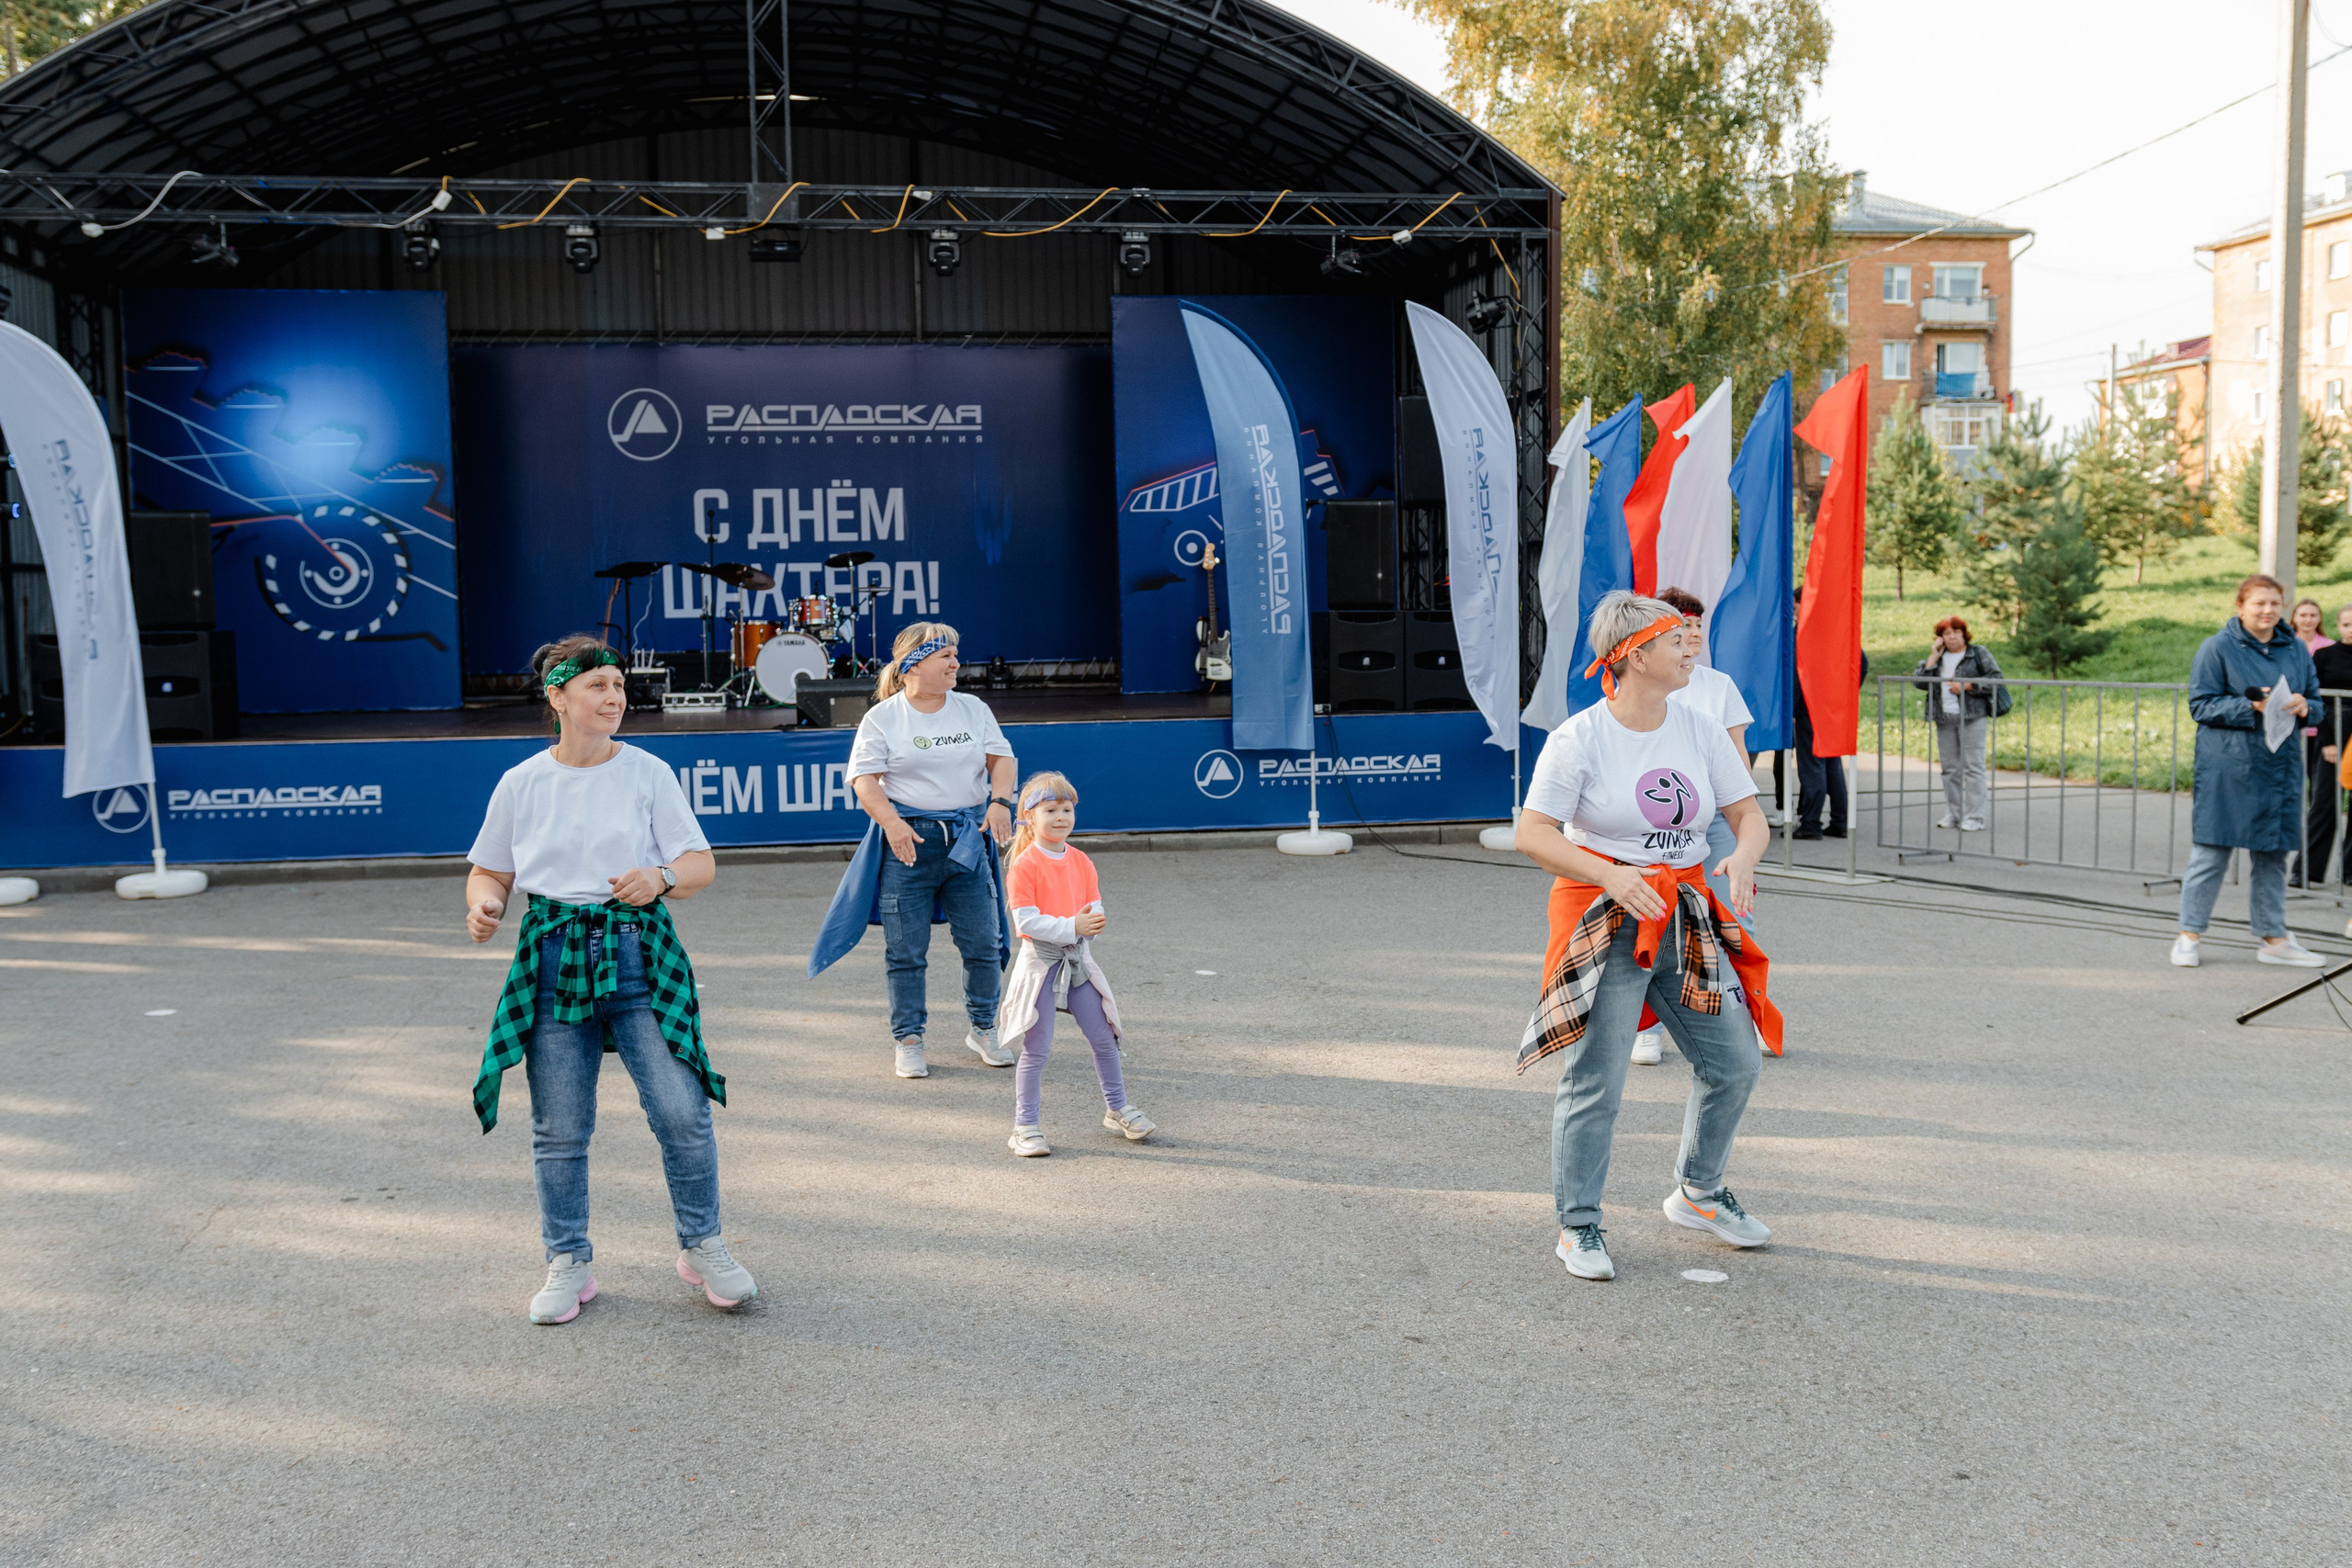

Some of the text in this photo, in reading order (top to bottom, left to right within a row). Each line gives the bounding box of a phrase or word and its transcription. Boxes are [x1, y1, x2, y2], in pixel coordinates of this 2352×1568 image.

[706, 403, 983, 432] РАСПАДСКАЯ
[707, 434, 983, 445] УГОЛЬНАЯ КОМПАНИЯ
[693, 479, 906, 550] С ДНЁМ
[932, 732, 974, 746] ZUMBA
[1259, 754, 1442, 779] РАСПАДСКАЯ
[1357, 775, 1442, 784] КОМПАНИЯ
[167, 784, 382, 811] РАСПАДСКАЯ
[1641, 829, 1696, 850] ZUMBA
